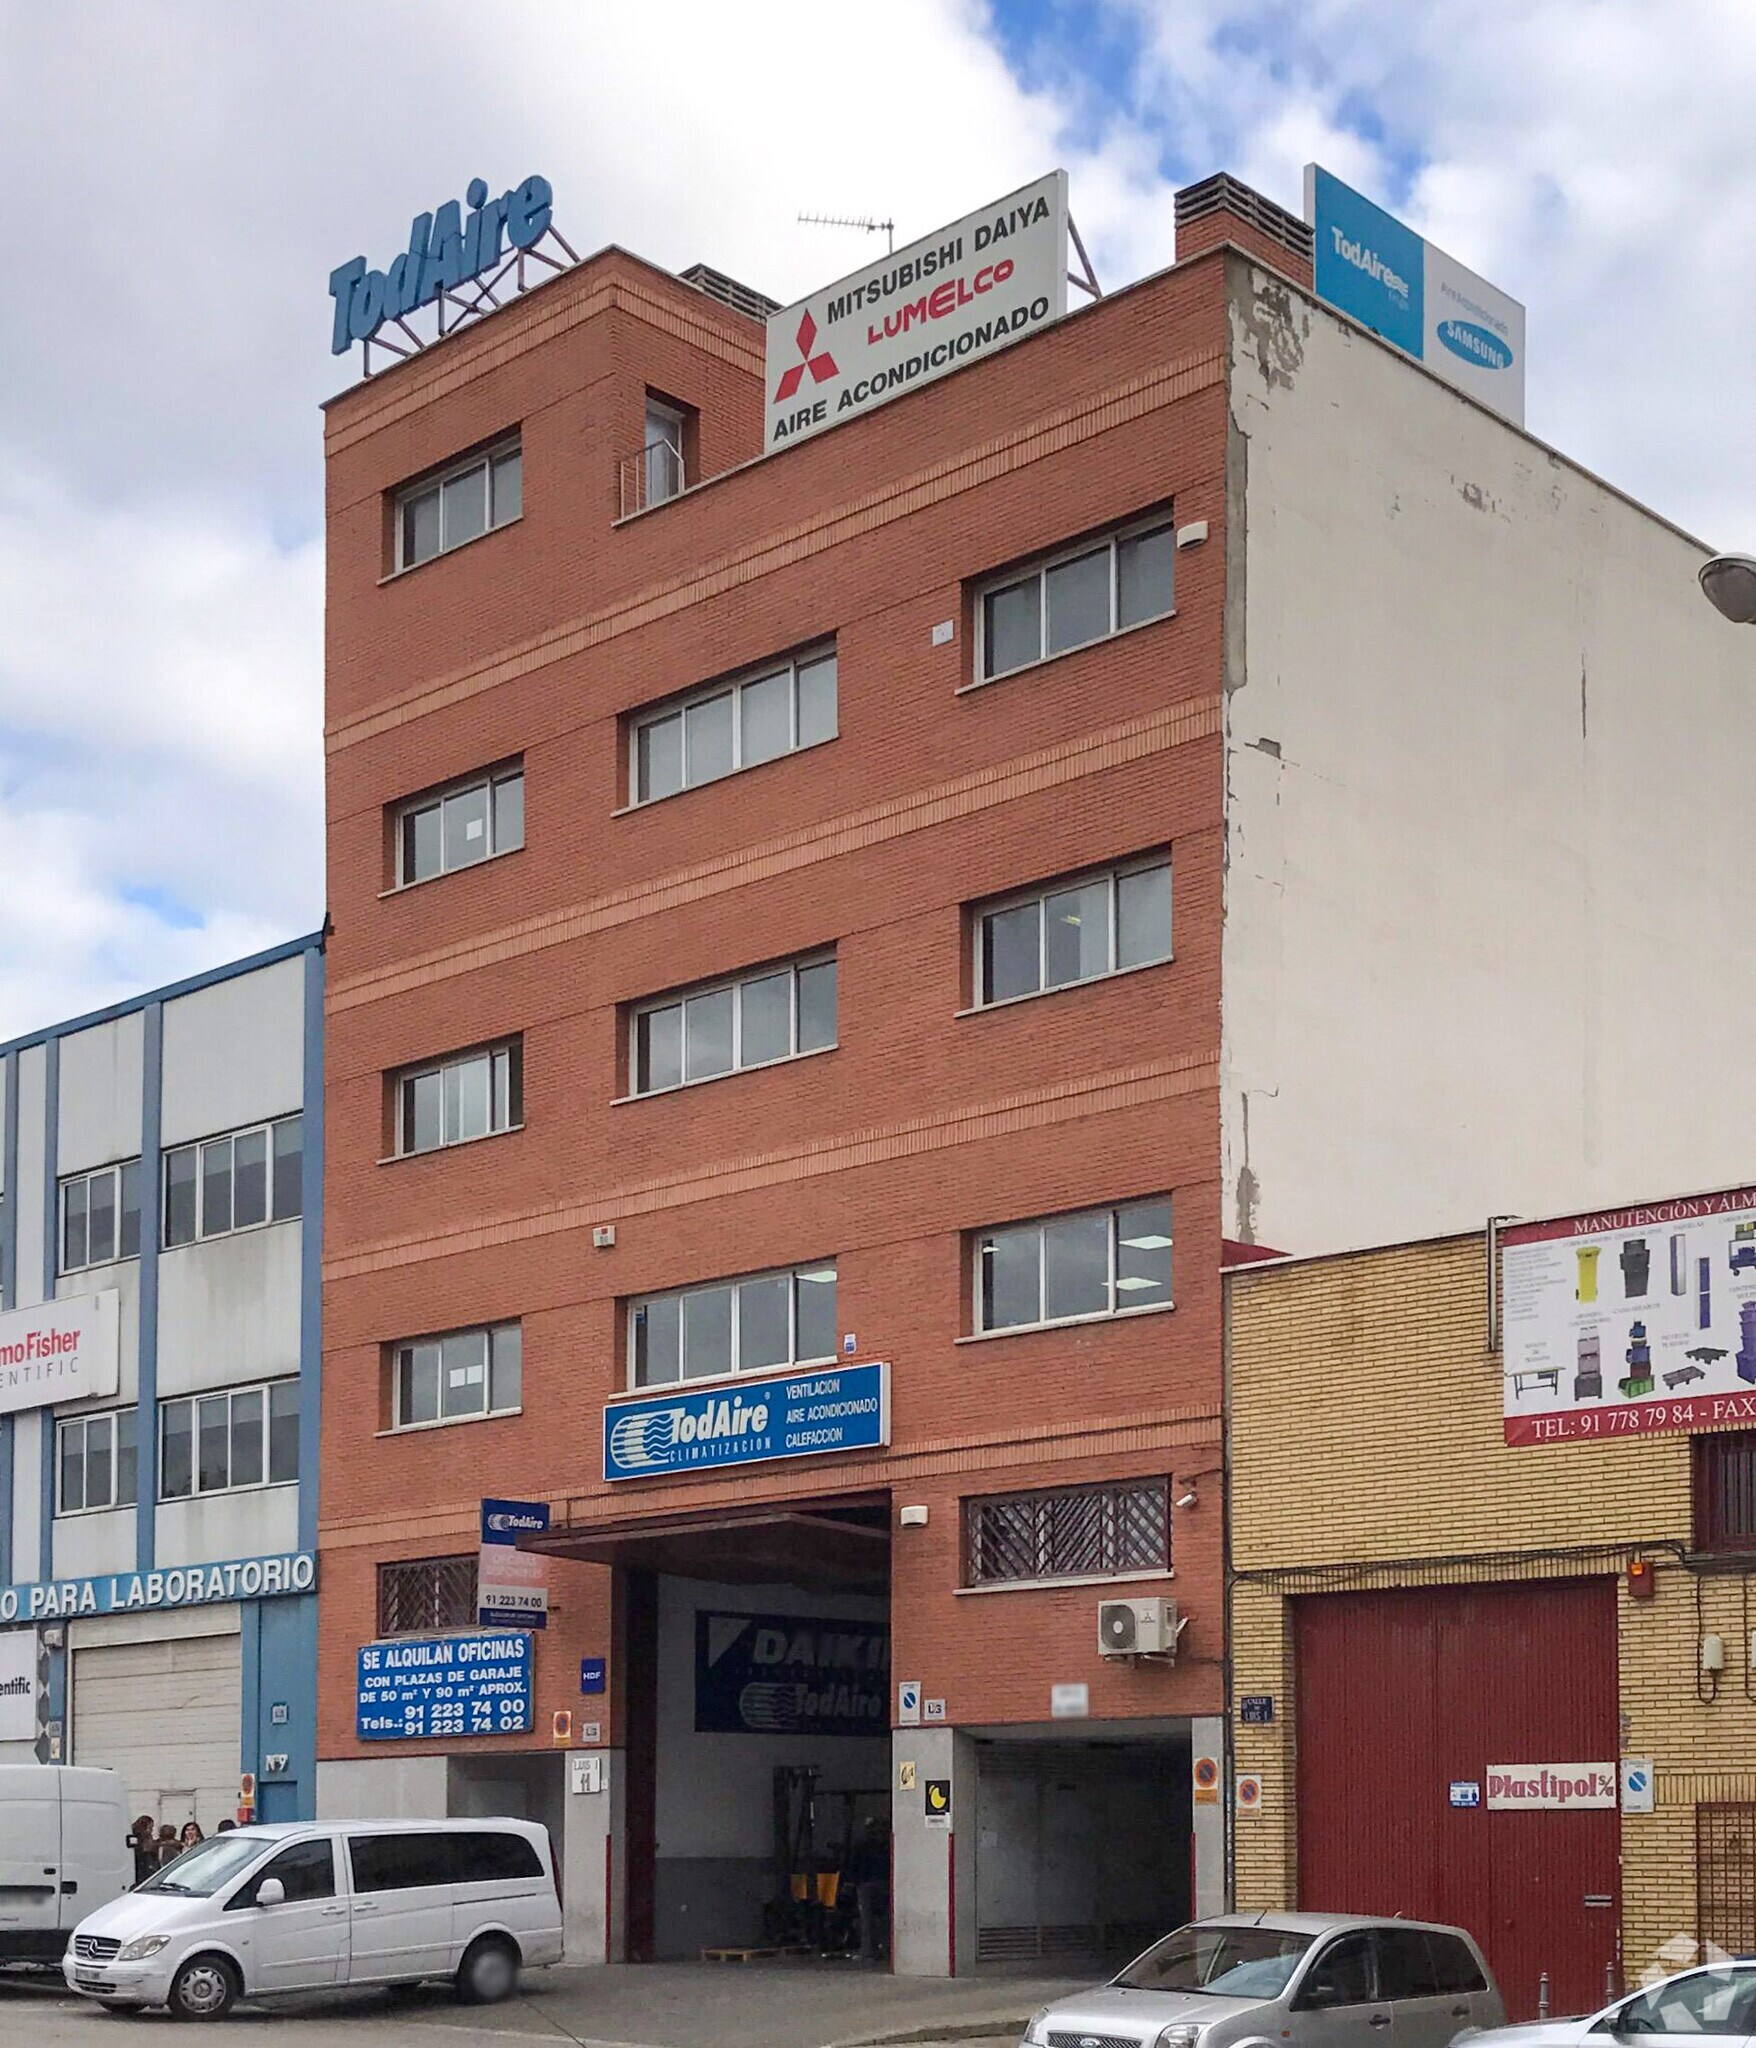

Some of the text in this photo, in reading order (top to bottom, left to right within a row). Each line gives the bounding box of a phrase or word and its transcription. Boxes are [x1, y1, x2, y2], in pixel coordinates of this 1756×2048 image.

[329, 175, 553, 356] TodAire
[827, 196, 1050, 324] MITSUBISHI DAIYA
[867, 259, 1015, 345] LUMELCO
[1447, 320, 1504, 369] SAMSUNG
[773, 297, 1050, 441] AIRE ACONDICIONADO
[1703, 1199, 1715, 1214] Y
[786, 1378, 841, 1400] VENTILACION
[669, 1396, 769, 1445] TodAire
[786, 1398, 878, 1424] AIRE ACONDICIONADO
[1532, 1417, 1576, 1438] TEL:
[1581, 1414, 1600, 1433] 91
[1608, 1409, 1639, 1430] 778
[1647, 1407, 1667, 1426] 79
[1672, 1404, 1694, 1424] 84
[1713, 1397, 1756, 1420] FAX
[670, 1437, 771, 1463] CLIMATIZACION
[786, 1428, 843, 1449] CALEFACCION
[30, 1581, 97, 1617] PARA
[110, 1554, 314, 1609] LABORATORIO
[486, 1594, 542, 1608] 91 223 74 00
[363, 1638, 525, 1670] SE ALQUILAN OFICINAS
[365, 1666, 522, 1688] CON PLAZAS DE GARAJE
[360, 1692, 376, 1703] DE
[381, 1690, 397, 1702] 50
[423, 1688, 431, 1699] Y
[436, 1686, 453, 1698] 90
[479, 1681, 527, 1696] APROX.
[404, 1699, 525, 1720] 91 223 74 00
[361, 1715, 525, 1735] Tels.: 91 223 74 02
[574, 1760, 591, 1771] LUIS
[1487, 1770, 1598, 1803] Plastipol
